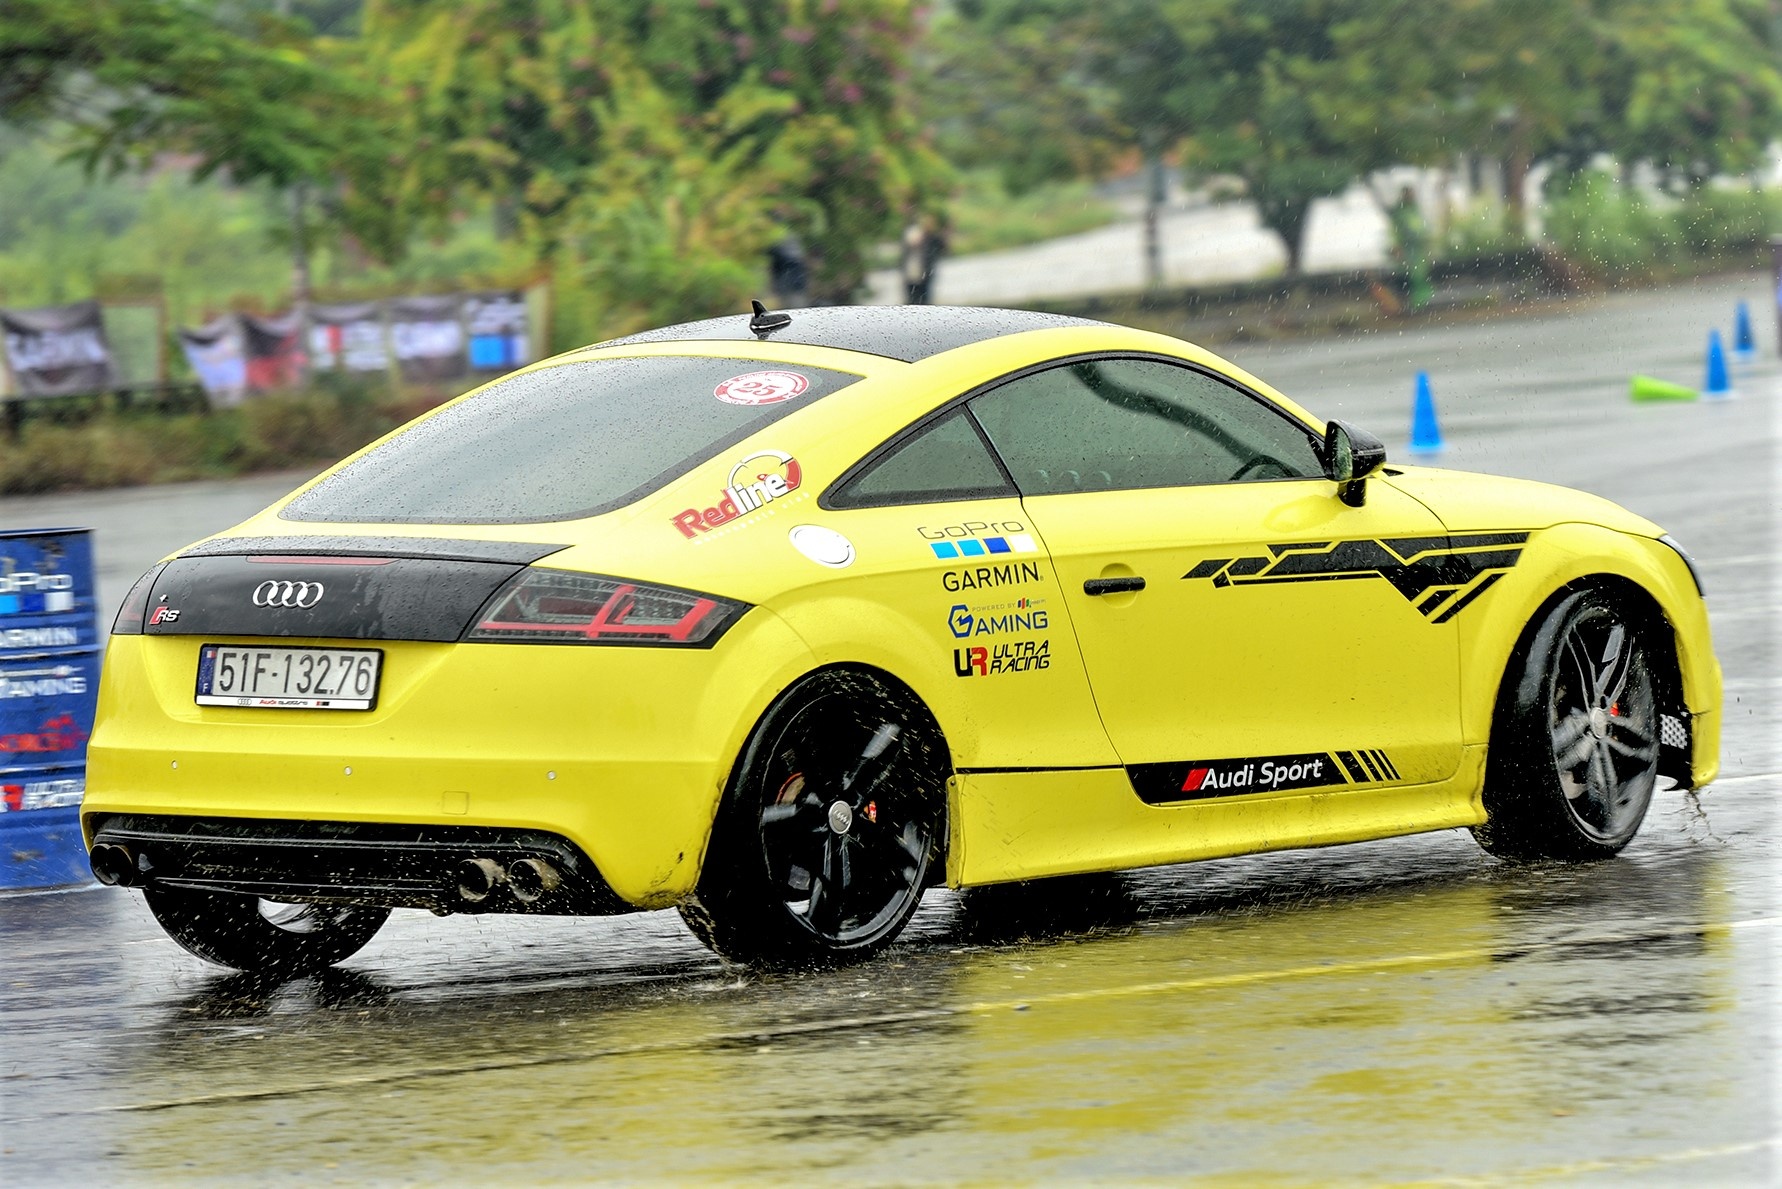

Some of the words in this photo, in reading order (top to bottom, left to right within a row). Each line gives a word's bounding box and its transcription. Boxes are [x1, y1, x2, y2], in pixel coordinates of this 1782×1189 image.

[734, 381, 783, 396] 25
[670, 472, 790, 539] Redline
[917, 521, 1025, 540] GoPro
[0, 572, 73, 593] oPro
[943, 562, 1041, 592] GARMIN
[155, 609, 180, 622] RS
[971, 602, 1005, 613] POWERED
[1007, 601, 1016, 610] BY
[948, 604, 1048, 638] GAMING
[993, 640, 1049, 659] ULTRA
[953, 647, 988, 678] UR
[990, 654, 1051, 675] RACING
[219, 652, 373, 696] 51F-132.76
[201, 683, 209, 693] F
[1200, 764, 1255, 790] Audi
[1259, 759, 1323, 788] Sport
